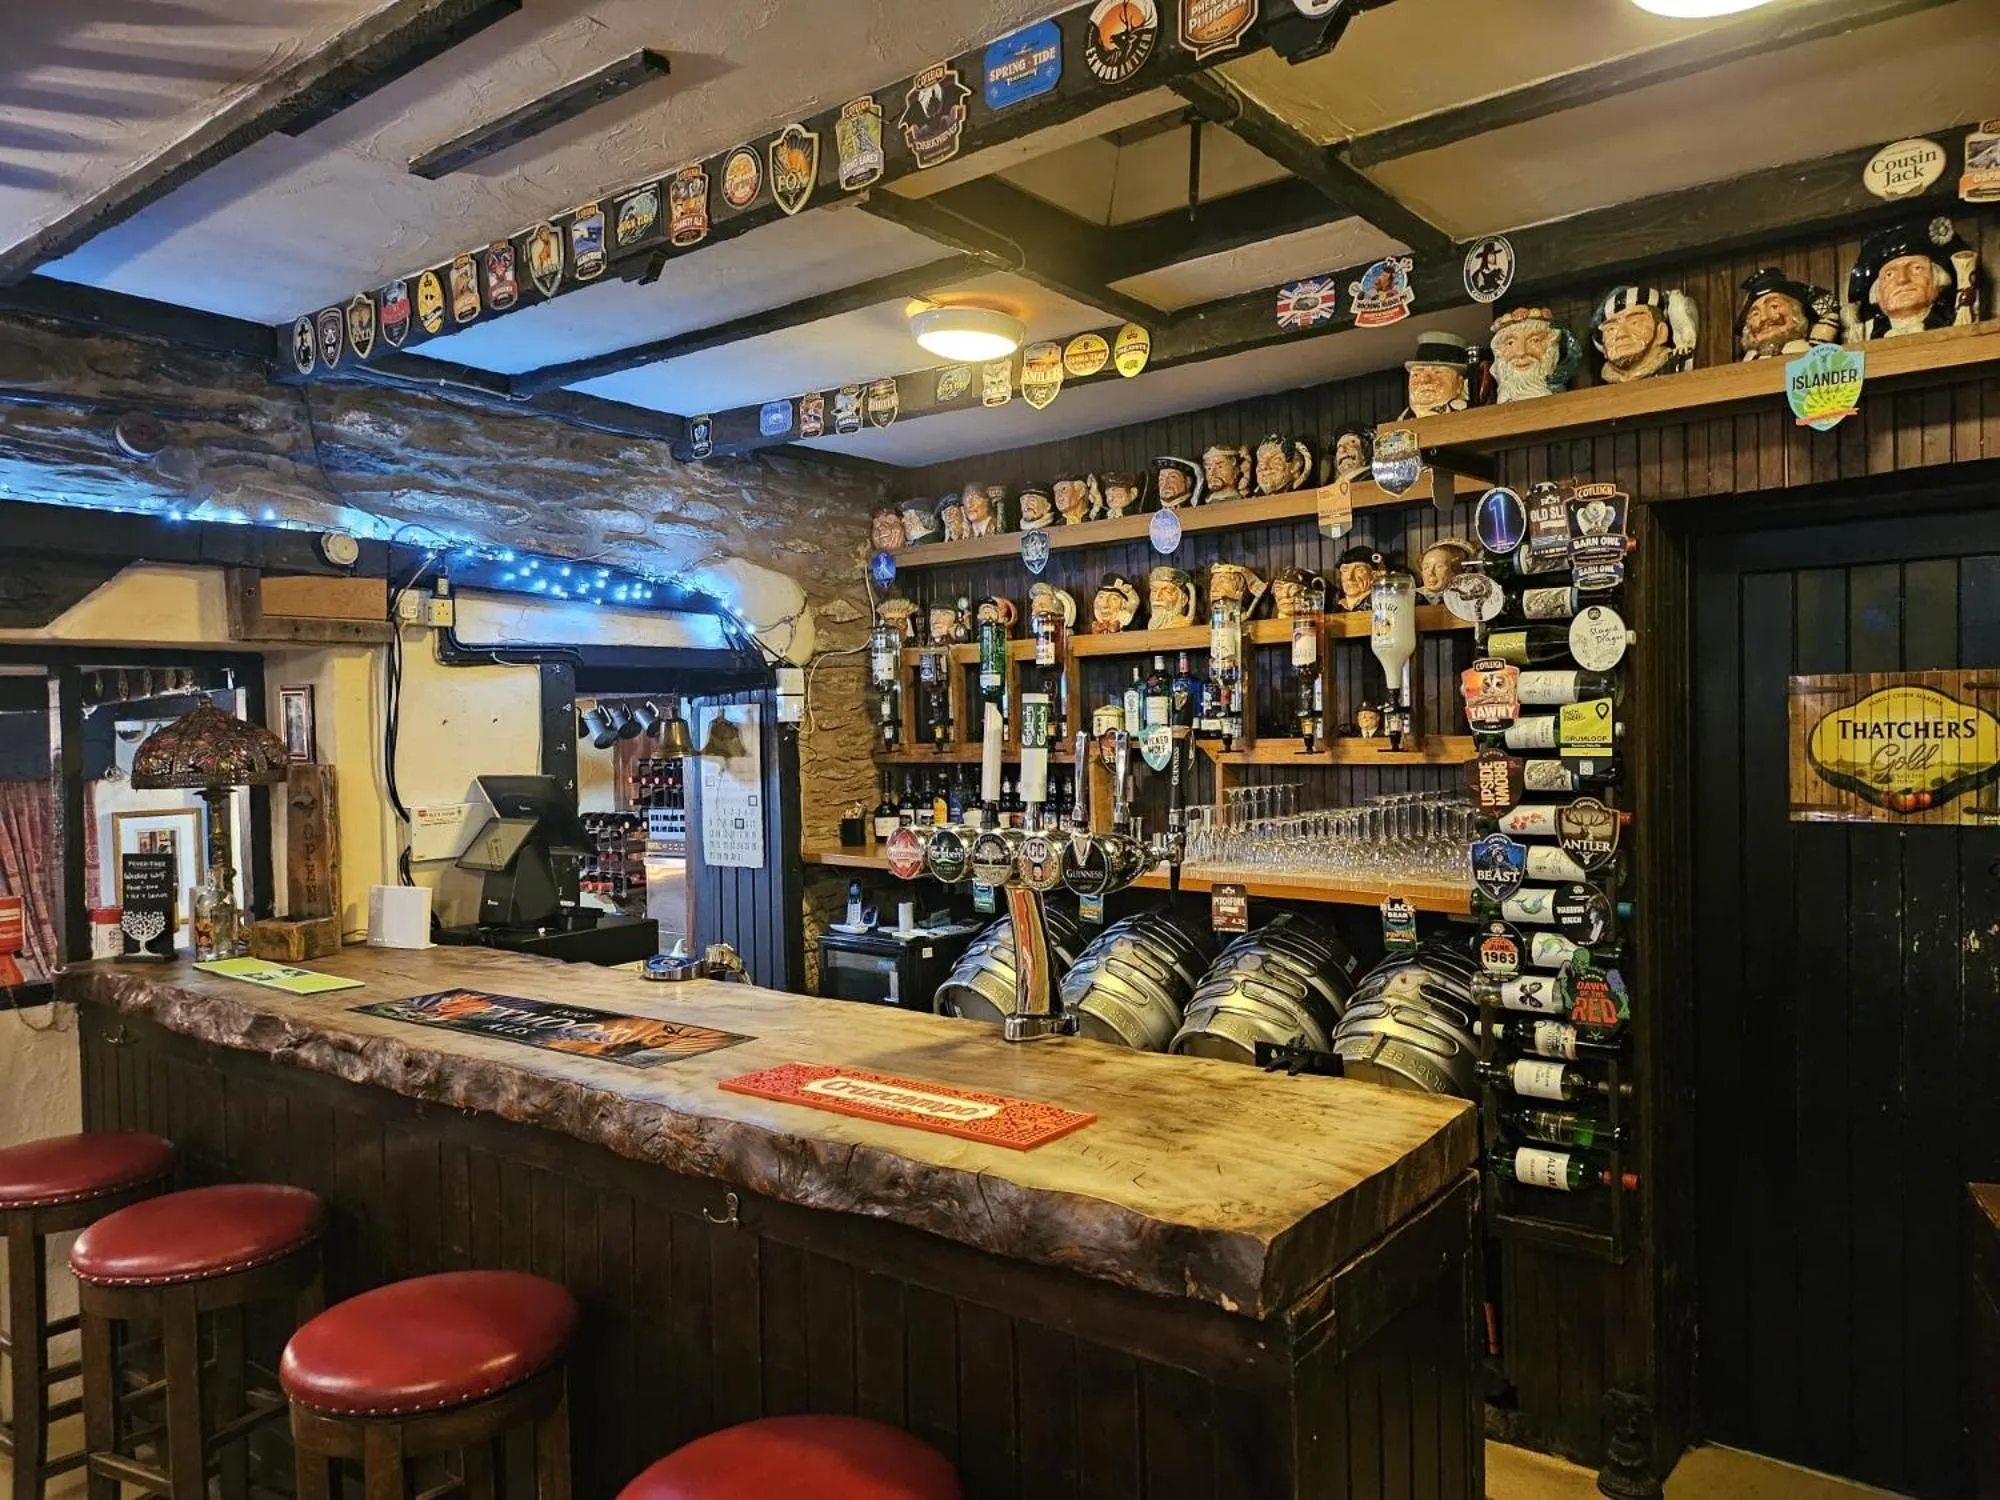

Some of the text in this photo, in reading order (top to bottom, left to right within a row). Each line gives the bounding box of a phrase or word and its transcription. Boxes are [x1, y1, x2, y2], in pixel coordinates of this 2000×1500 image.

[989, 46, 1056, 83] SPRING TIDE
[1085, 33, 1152, 80] EXMOOR ANTLER
[1871, 149, 1937, 175] Cousin
[777, 172, 810, 194] FOX
[1884, 165, 1925, 189] Jack
[1792, 368, 1858, 392] ISLANDER
[1578, 486, 1613, 499] COTLEIGH
[1530, 508, 1548, 522] OLD
[1573, 535, 1621, 549] BARN OWL
[1469, 706, 1515, 721] TAWNY
[1837, 718, 1977, 740] THATCHERS
[1870, 742, 1940, 780] Gold
[1478, 761, 1496, 806] UPSIDE
[1493, 760, 1511, 806] BROWN
[1562, 840, 1612, 853] ANTLER
[1066, 868, 1104, 879] GUINNESS
[1477, 868, 1521, 883] BEAST
[1380, 903, 1415, 912] BLACK
[1483, 951, 1517, 965] 1963
[1576, 980, 1609, 992] DAWN
[1571, 996, 1618, 1024] RED
[821, 1077, 983, 1117] Cruzcampo
